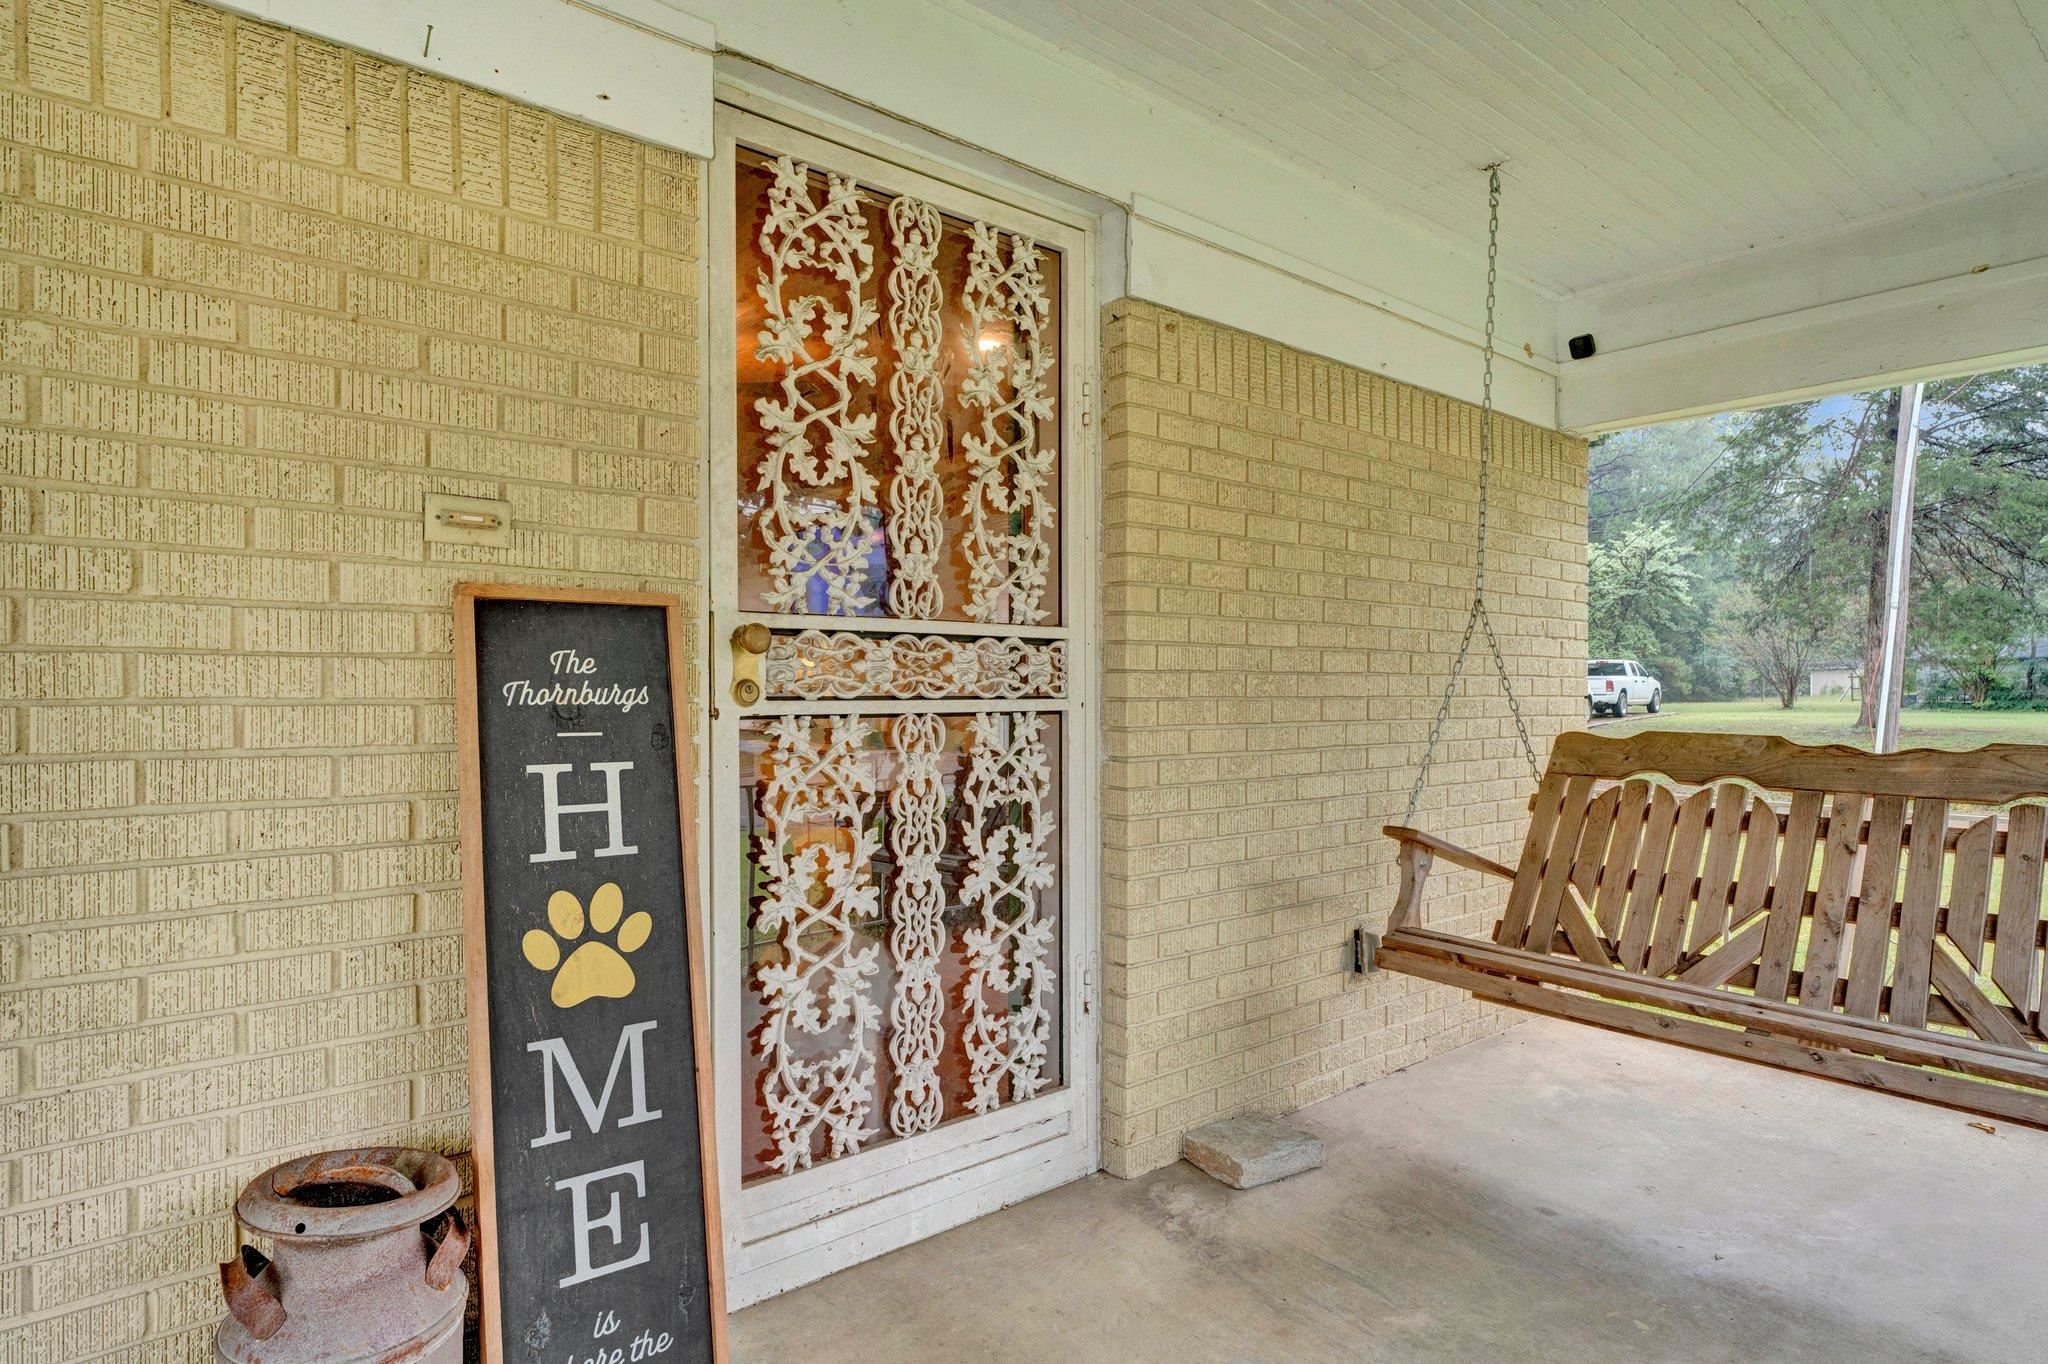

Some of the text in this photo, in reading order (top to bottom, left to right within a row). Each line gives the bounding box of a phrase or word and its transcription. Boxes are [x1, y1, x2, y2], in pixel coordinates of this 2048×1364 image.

[550, 649, 598, 675] The
[502, 680, 650, 713] Thornburgs
[593, 1310, 621, 1339] is
[630, 1328, 675, 1362] the
